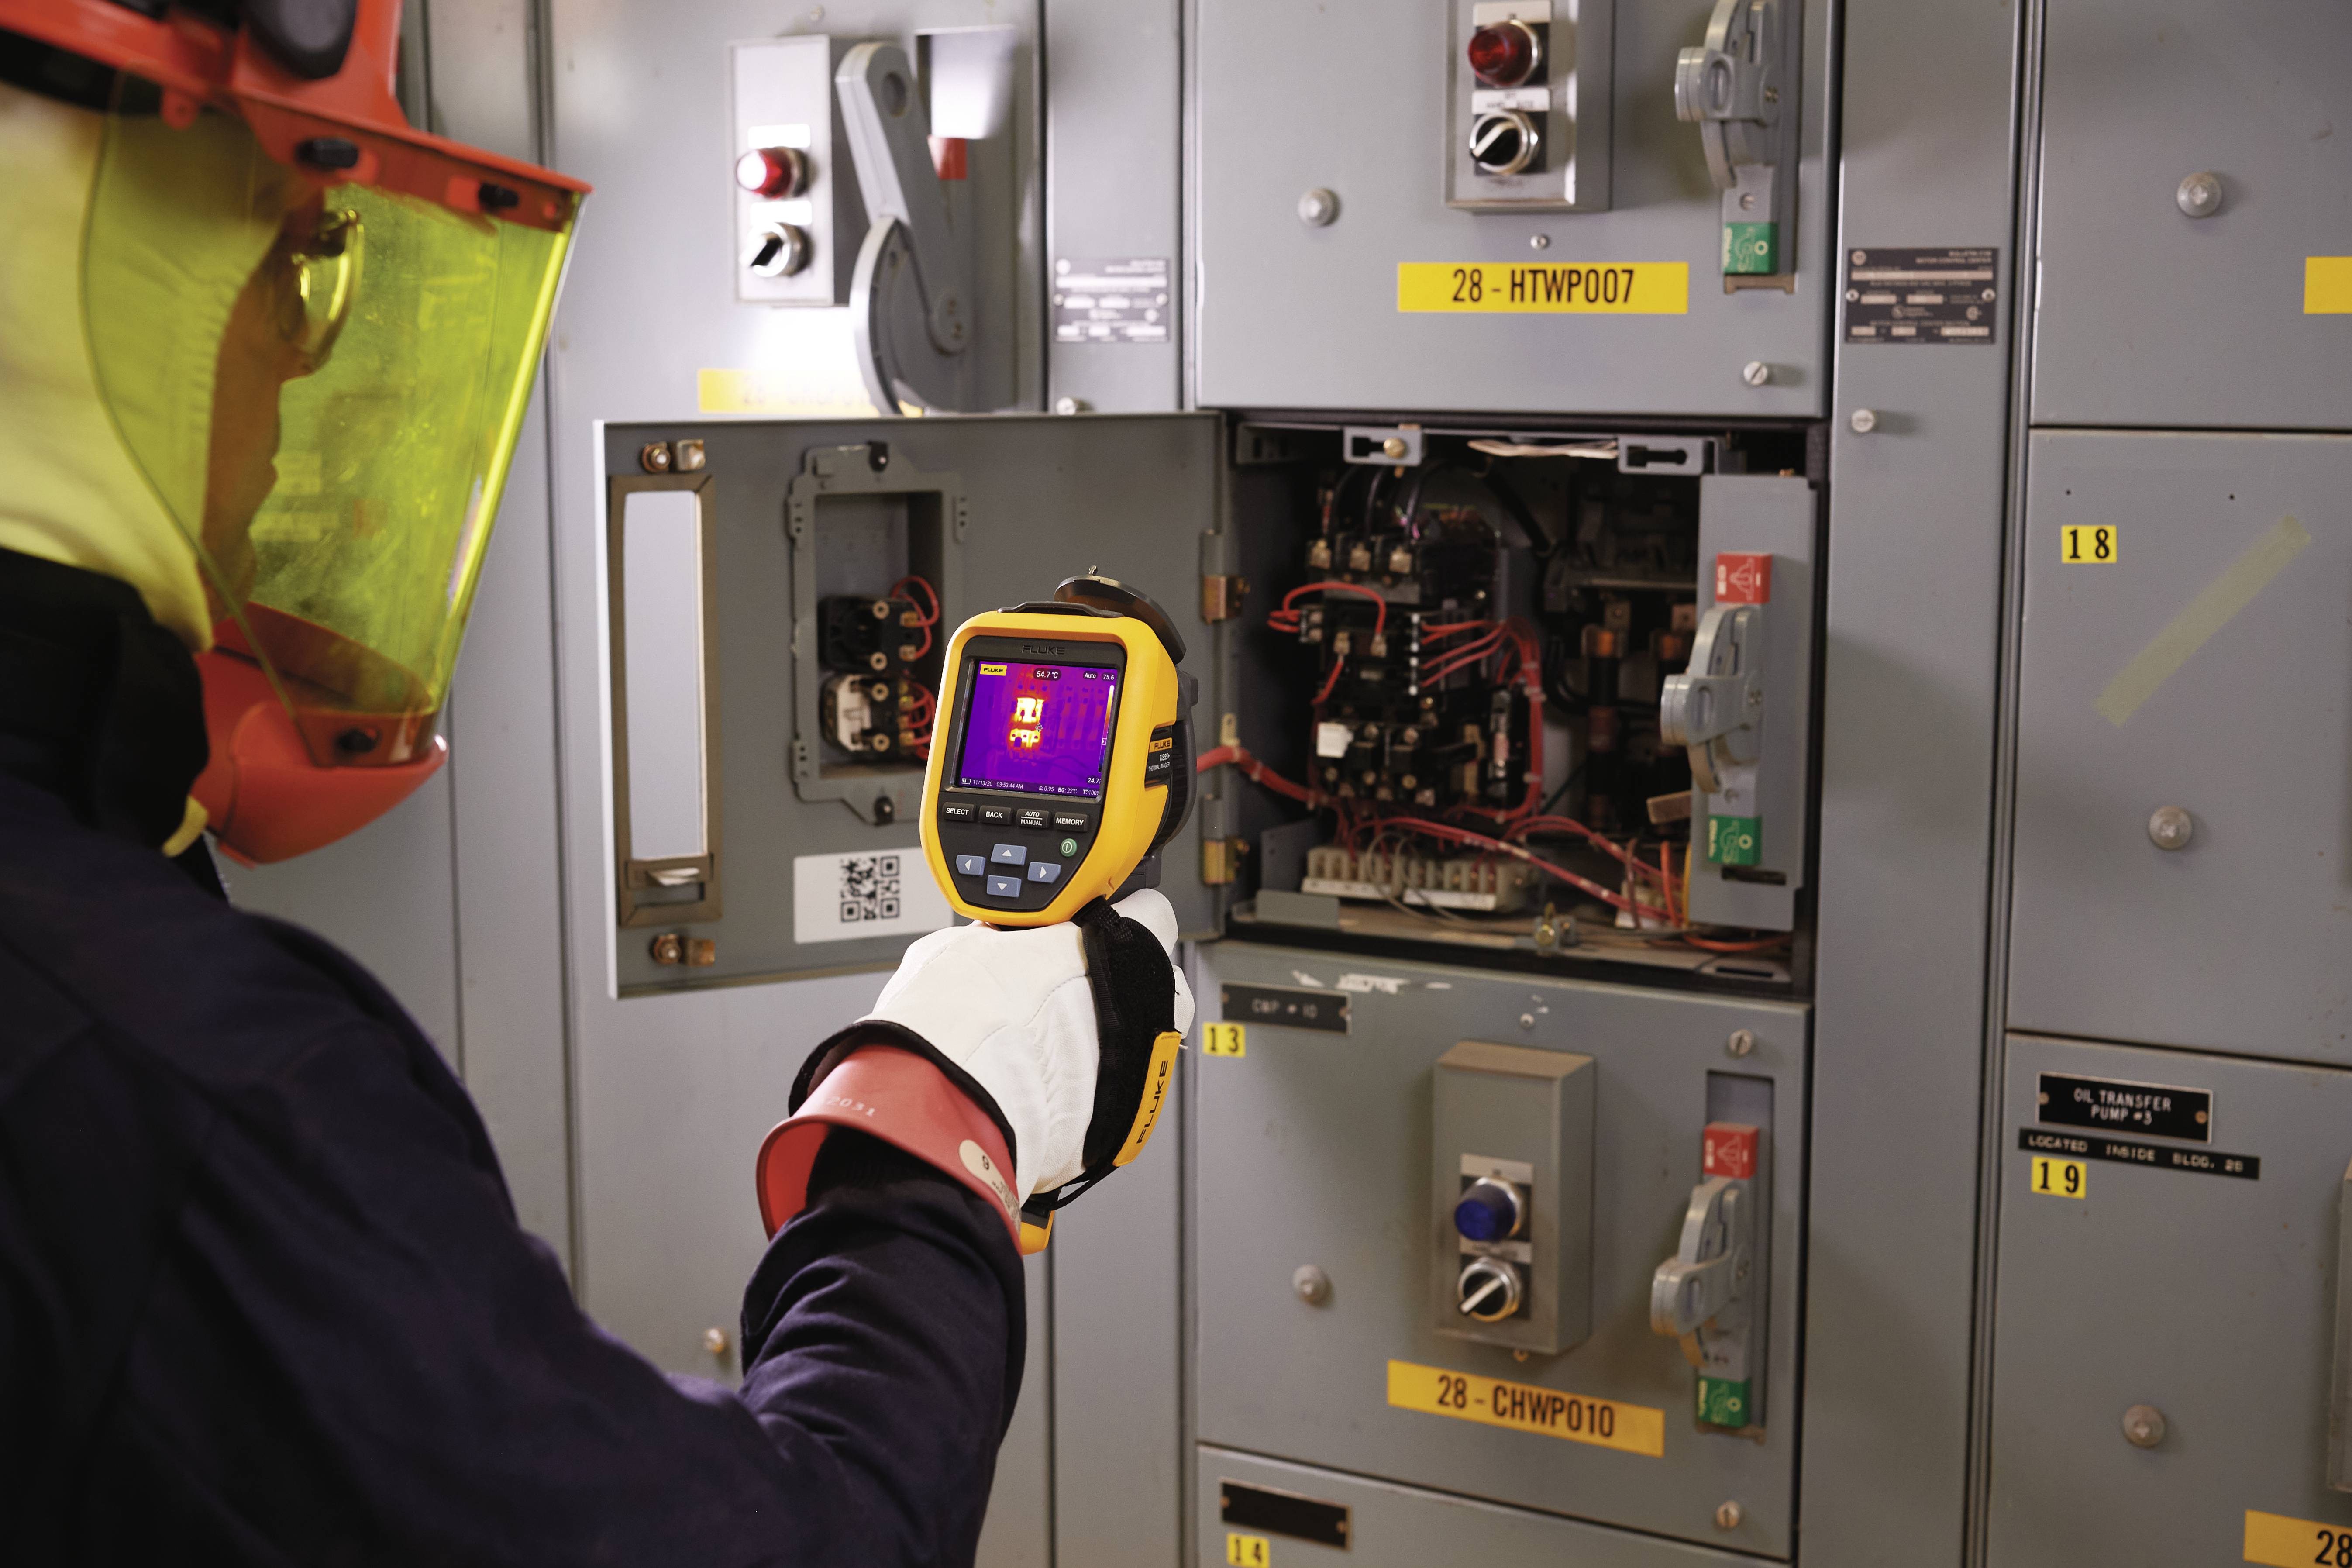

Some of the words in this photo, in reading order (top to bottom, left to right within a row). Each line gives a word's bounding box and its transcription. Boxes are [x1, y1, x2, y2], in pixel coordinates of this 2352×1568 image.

[2069, 528, 2110, 559] 18
[1021, 645, 1065, 655] FLUKE
[1154, 740, 1170, 750] FLUKE
[1056, 817, 1084, 826] MEMORY
[1209, 1027, 1239, 1053] 13
[1136, 1060, 1168, 1144] FLUKE
[2074, 1087, 2094, 1104] OIL
[2099, 1089, 2172, 1112] TRANSFER
[2090, 1104, 2129, 1122] PUMP
[2028, 1135, 2088, 1153] LOCATED
[2106, 1144, 2156, 1162] INSIDE
[2040, 1161, 2079, 1193] 19
[2314, 1530, 2352, 1568] 28
